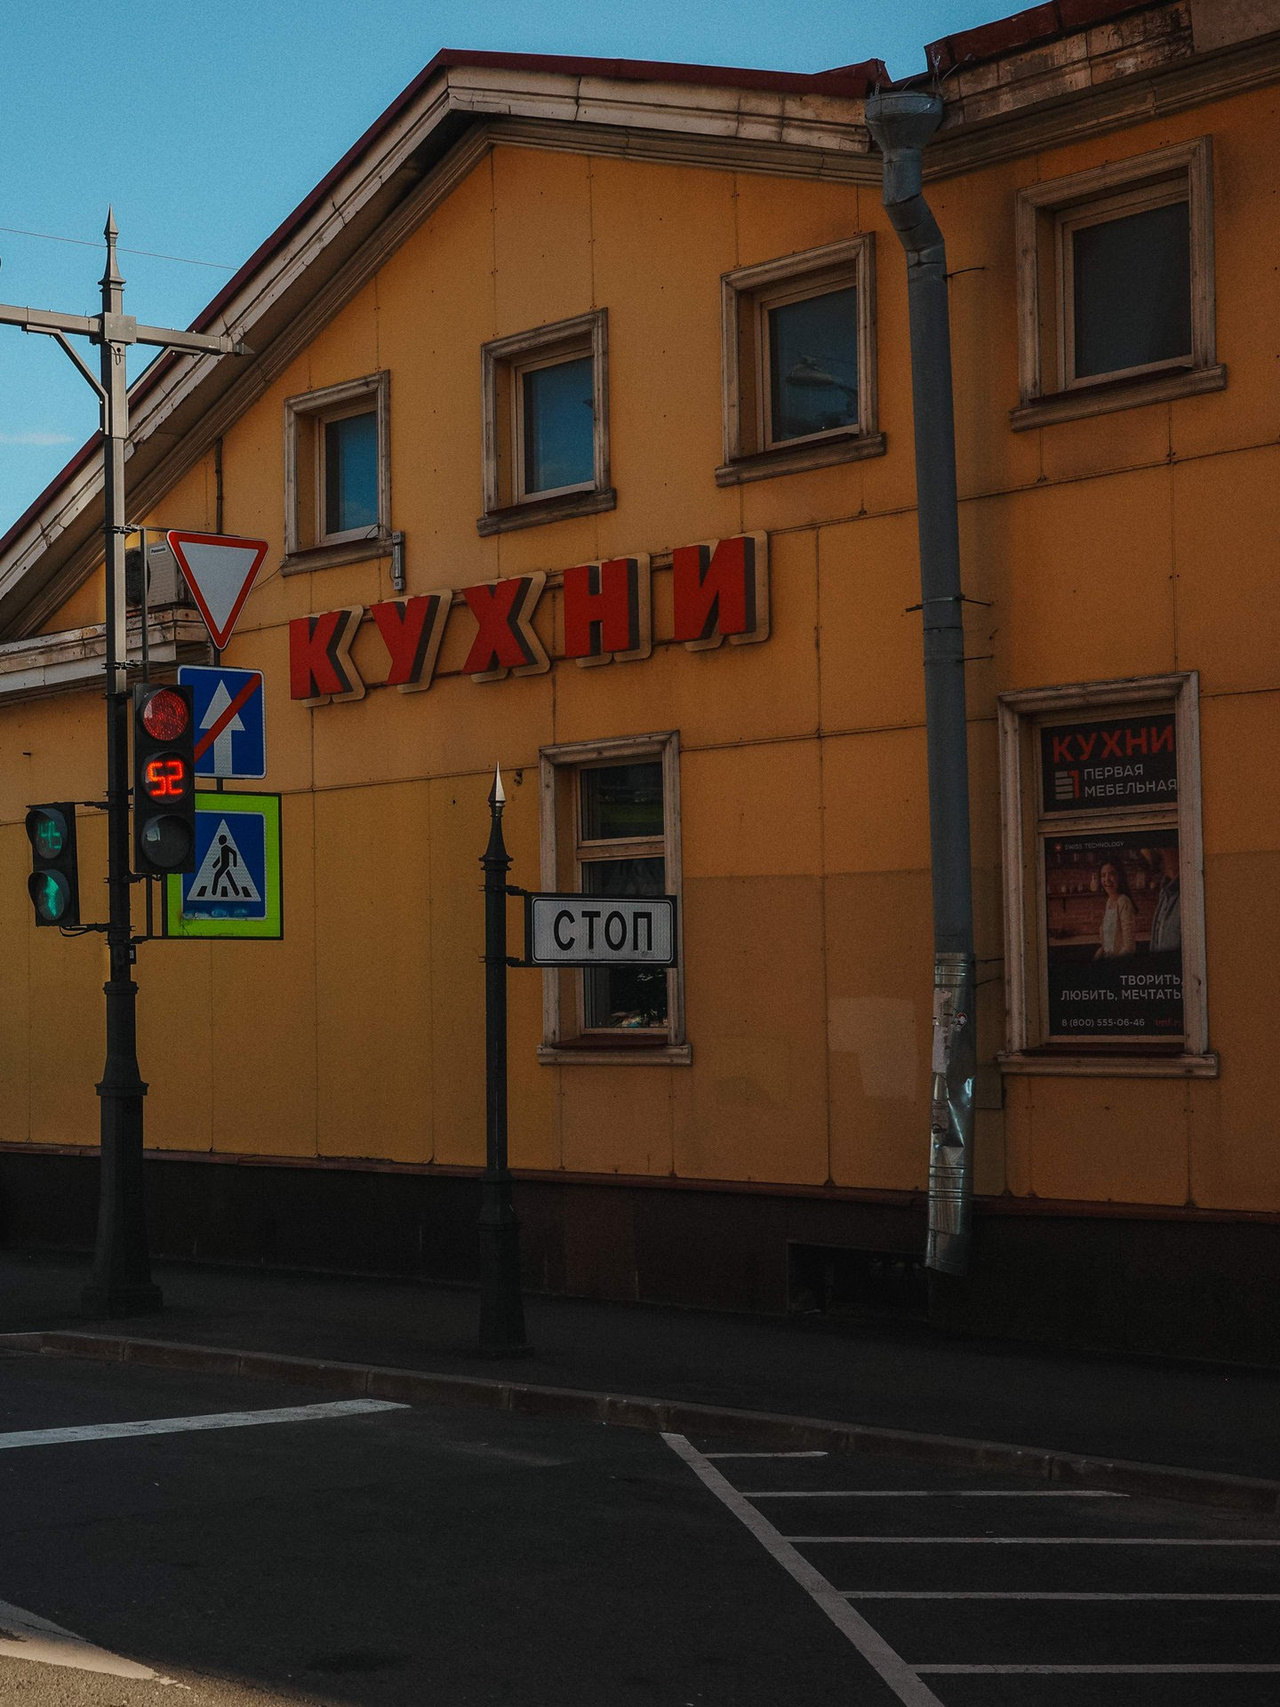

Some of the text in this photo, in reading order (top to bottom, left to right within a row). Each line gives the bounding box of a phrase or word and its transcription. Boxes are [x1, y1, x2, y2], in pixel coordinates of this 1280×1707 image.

[290, 534, 762, 704] КУХНИ
[1052, 725, 1175, 764] КУХНИ
[144, 760, 184, 797] 52
[1083, 764, 1144, 780] ПЕРВАЯ
[1084, 779, 1177, 797] МЕБЕЛЬНАЯ
[1064, 840, 1125, 850] SWISS TECHNOLOGY
[553, 909, 653, 952] СТОП
[1061, 990, 1118, 1001] ЛЮБИТЬ,
[1061, 1018, 1067, 1027] 8
[1069, 1018, 1095, 1028] (800)
[1097, 1018, 1145, 1027] 555-06-46
